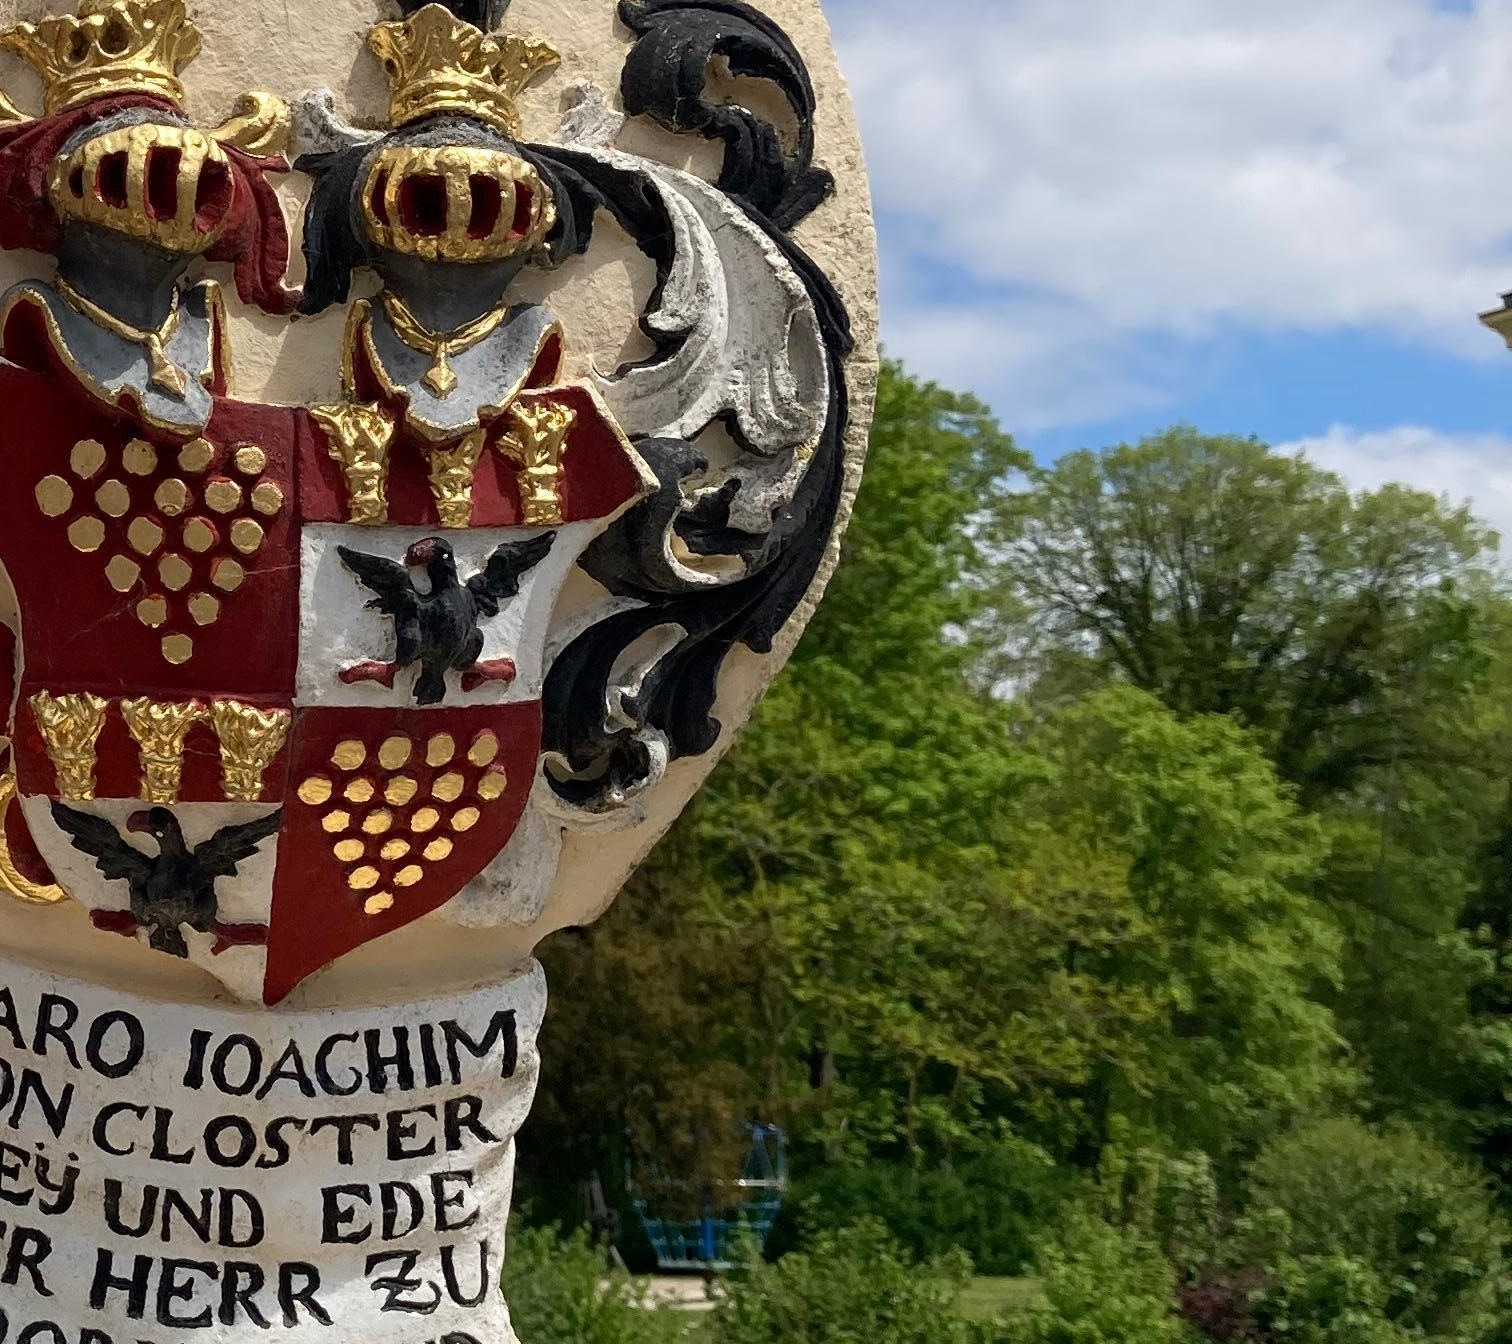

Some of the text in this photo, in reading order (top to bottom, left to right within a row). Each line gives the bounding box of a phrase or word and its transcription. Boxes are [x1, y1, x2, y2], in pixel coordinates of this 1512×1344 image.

[183, 1009, 517, 1100] IOACHIM
[92, 1095, 499, 1168] CLOSTER
[103, 1179, 265, 1248] UND
[320, 1171, 480, 1244] EDE
[89, 1249, 335, 1328] HERR
[364, 1241, 488, 1316] ZU
